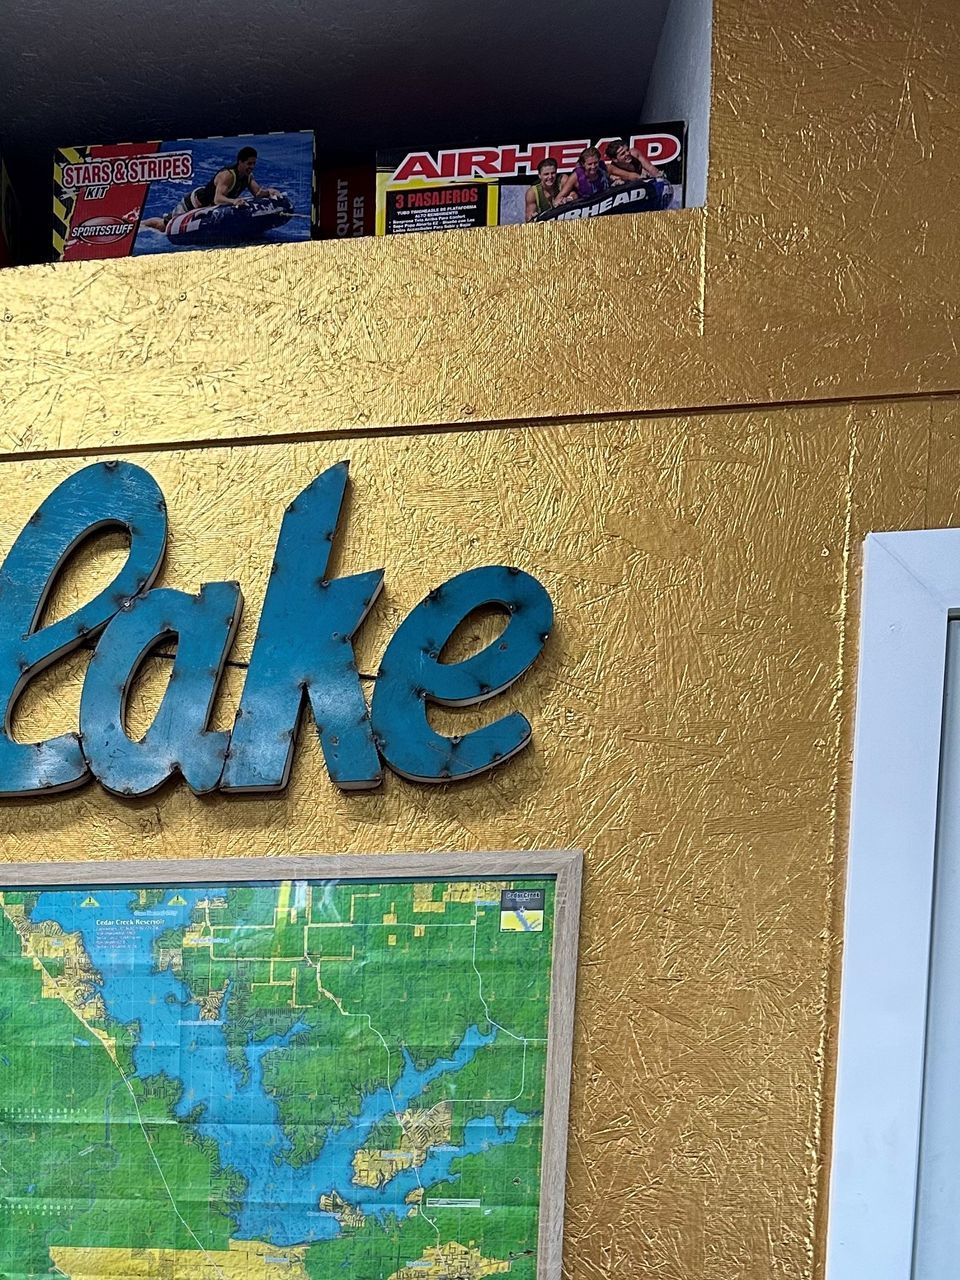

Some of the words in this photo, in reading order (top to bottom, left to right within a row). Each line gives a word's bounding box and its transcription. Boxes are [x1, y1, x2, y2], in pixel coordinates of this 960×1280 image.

[63, 162, 111, 188] STARS
[113, 161, 126, 182] &
[128, 155, 193, 180] STRIPES
[84, 185, 110, 200] KIT
[395, 194, 404, 208] 3
[408, 188, 478, 208] PASAJEROS
[336, 179, 349, 236] QUENT
[352, 196, 365, 237] LYER
[71, 223, 135, 238] SPORTSSTUFF
